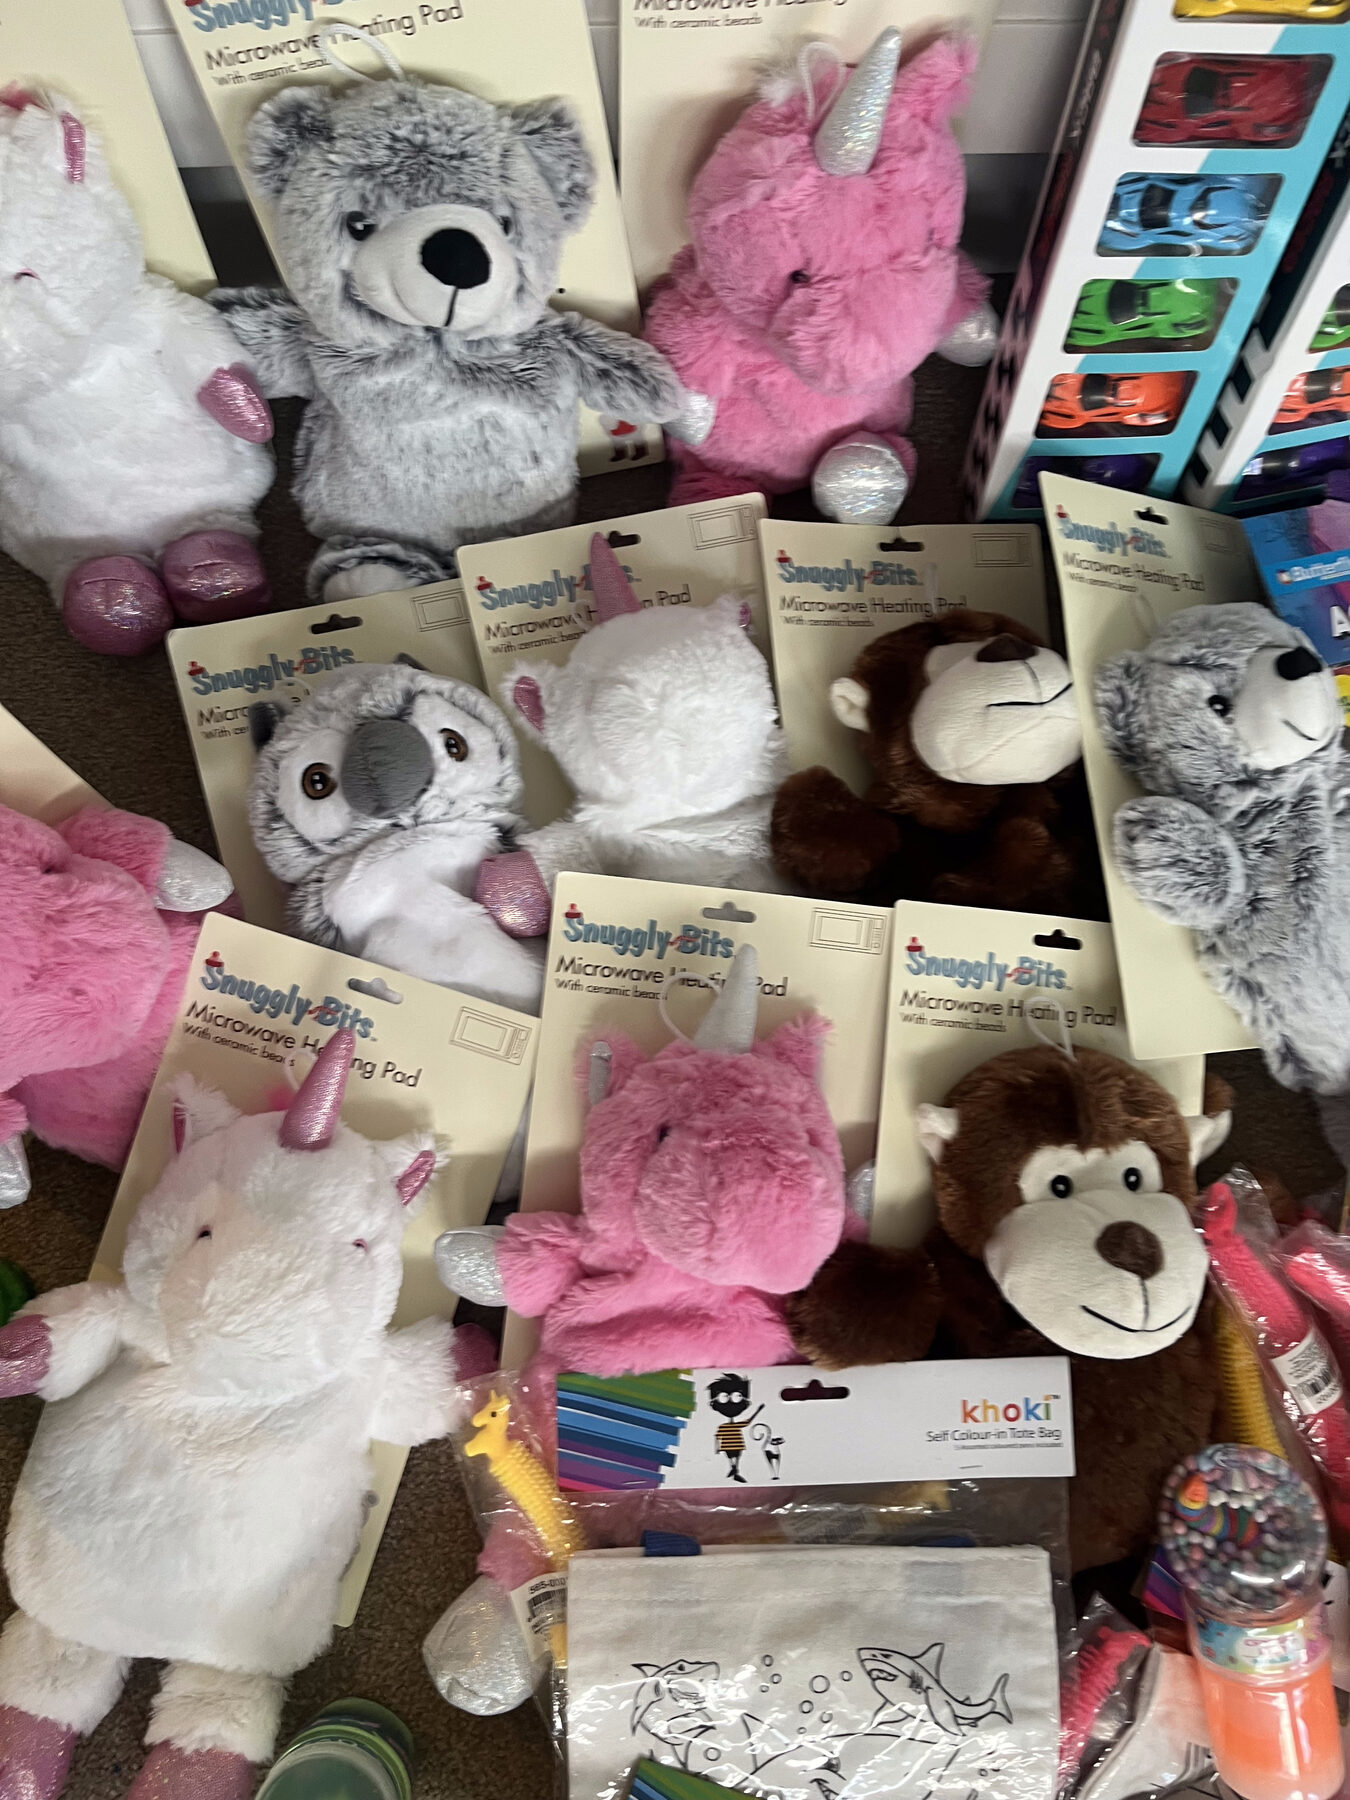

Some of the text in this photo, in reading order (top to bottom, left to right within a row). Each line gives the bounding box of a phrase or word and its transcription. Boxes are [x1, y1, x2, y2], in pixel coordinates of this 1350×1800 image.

[418, 0, 465, 26] Pad
[480, 569, 577, 611] Snuggly
[778, 559, 919, 593] Snuggly Bits
[780, 595, 868, 614] Microwave
[871, 597, 932, 618] Heating
[302, 645, 356, 675] Bits
[199, 705, 249, 726] Micro
[563, 917, 735, 960] Snuggly Bits
[555, 955, 665, 984] Microwave
[905, 950, 1067, 991] Snuggly Bits
[200, 964, 375, 1040] Snuggly Bits
[585, 983, 630, 998] ceramic
[900, 990, 1004, 1017] Microwave
[1081, 1005, 1117, 1027] Pad
[182, 1021, 212, 1041] With
[213, 1033, 259, 1056] ceramic
[186, 1000, 297, 1049] Microwave
[380, 1060, 423, 1088] Pad
[961, 1394, 1053, 1424] khoki
[926, 1426, 1063, 1442] Self Colour-in Tote Bag
